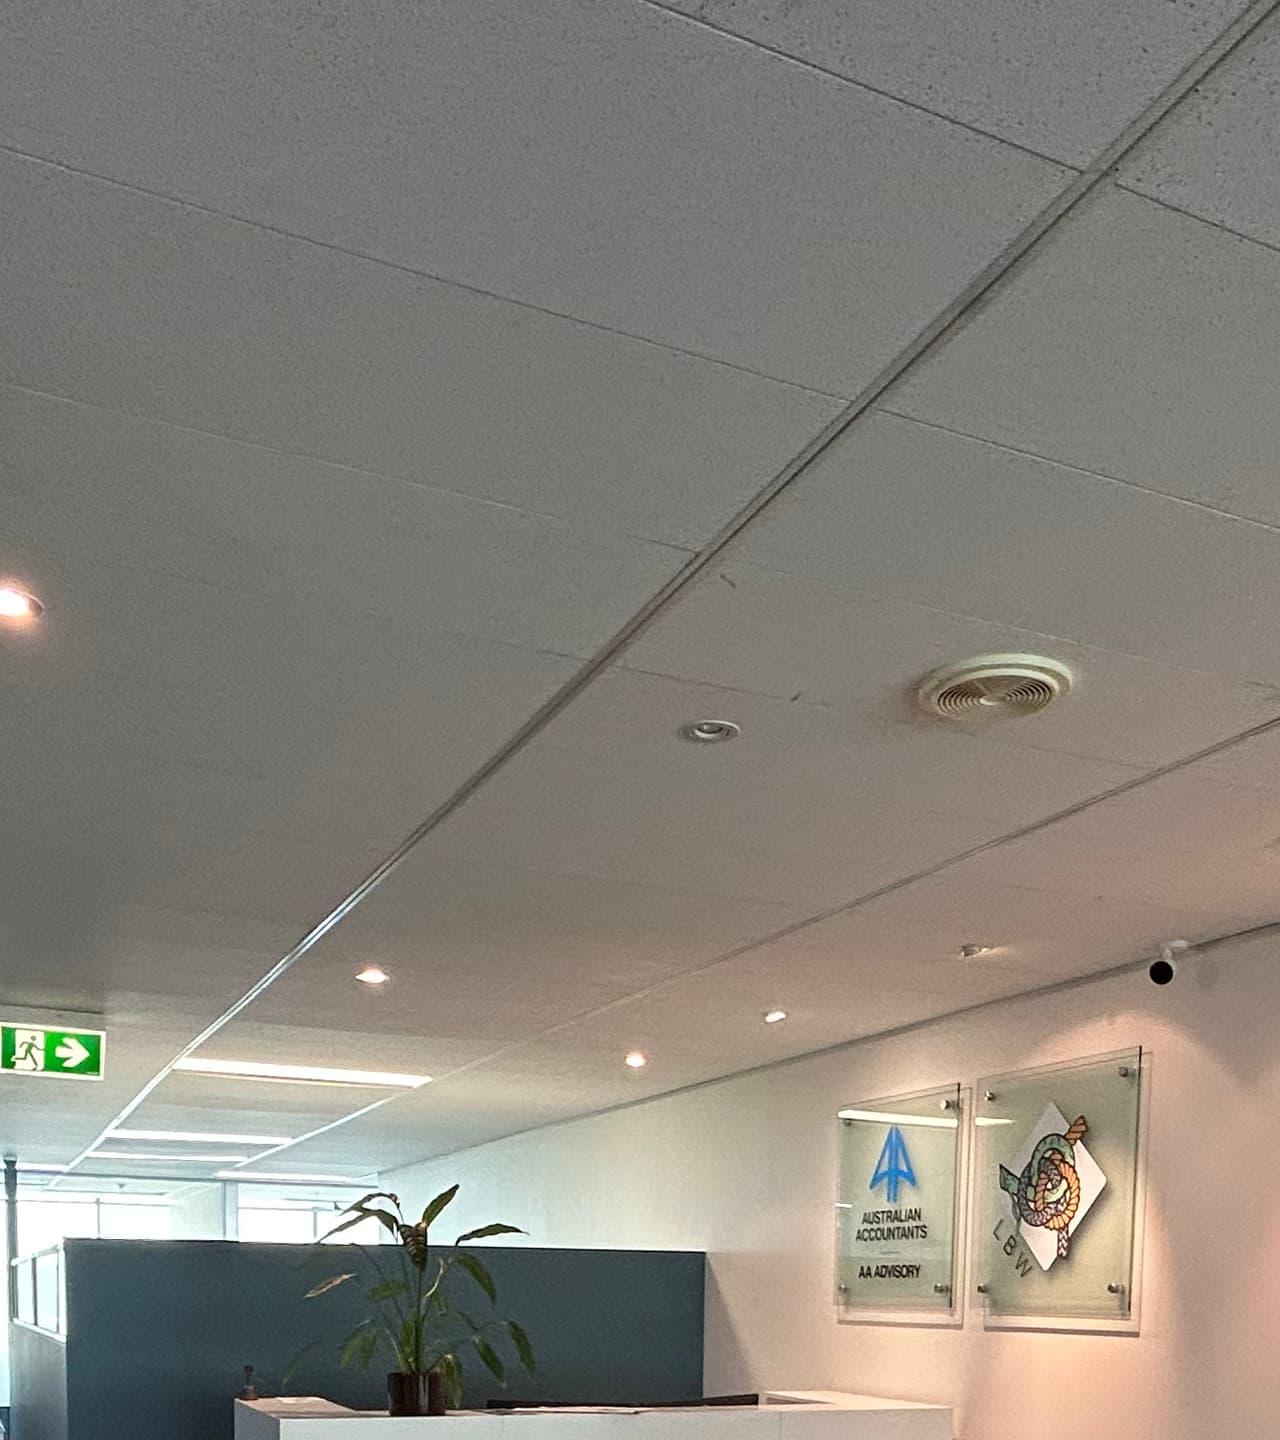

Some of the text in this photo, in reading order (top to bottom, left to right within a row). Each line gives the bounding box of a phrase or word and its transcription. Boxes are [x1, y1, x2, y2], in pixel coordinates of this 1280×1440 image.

[862, 1208, 922, 1224] AUSTRALIAN
[856, 1225, 928, 1241] ACCOUNTANTS
[859, 1264, 921, 1278] AA ADVISORY
